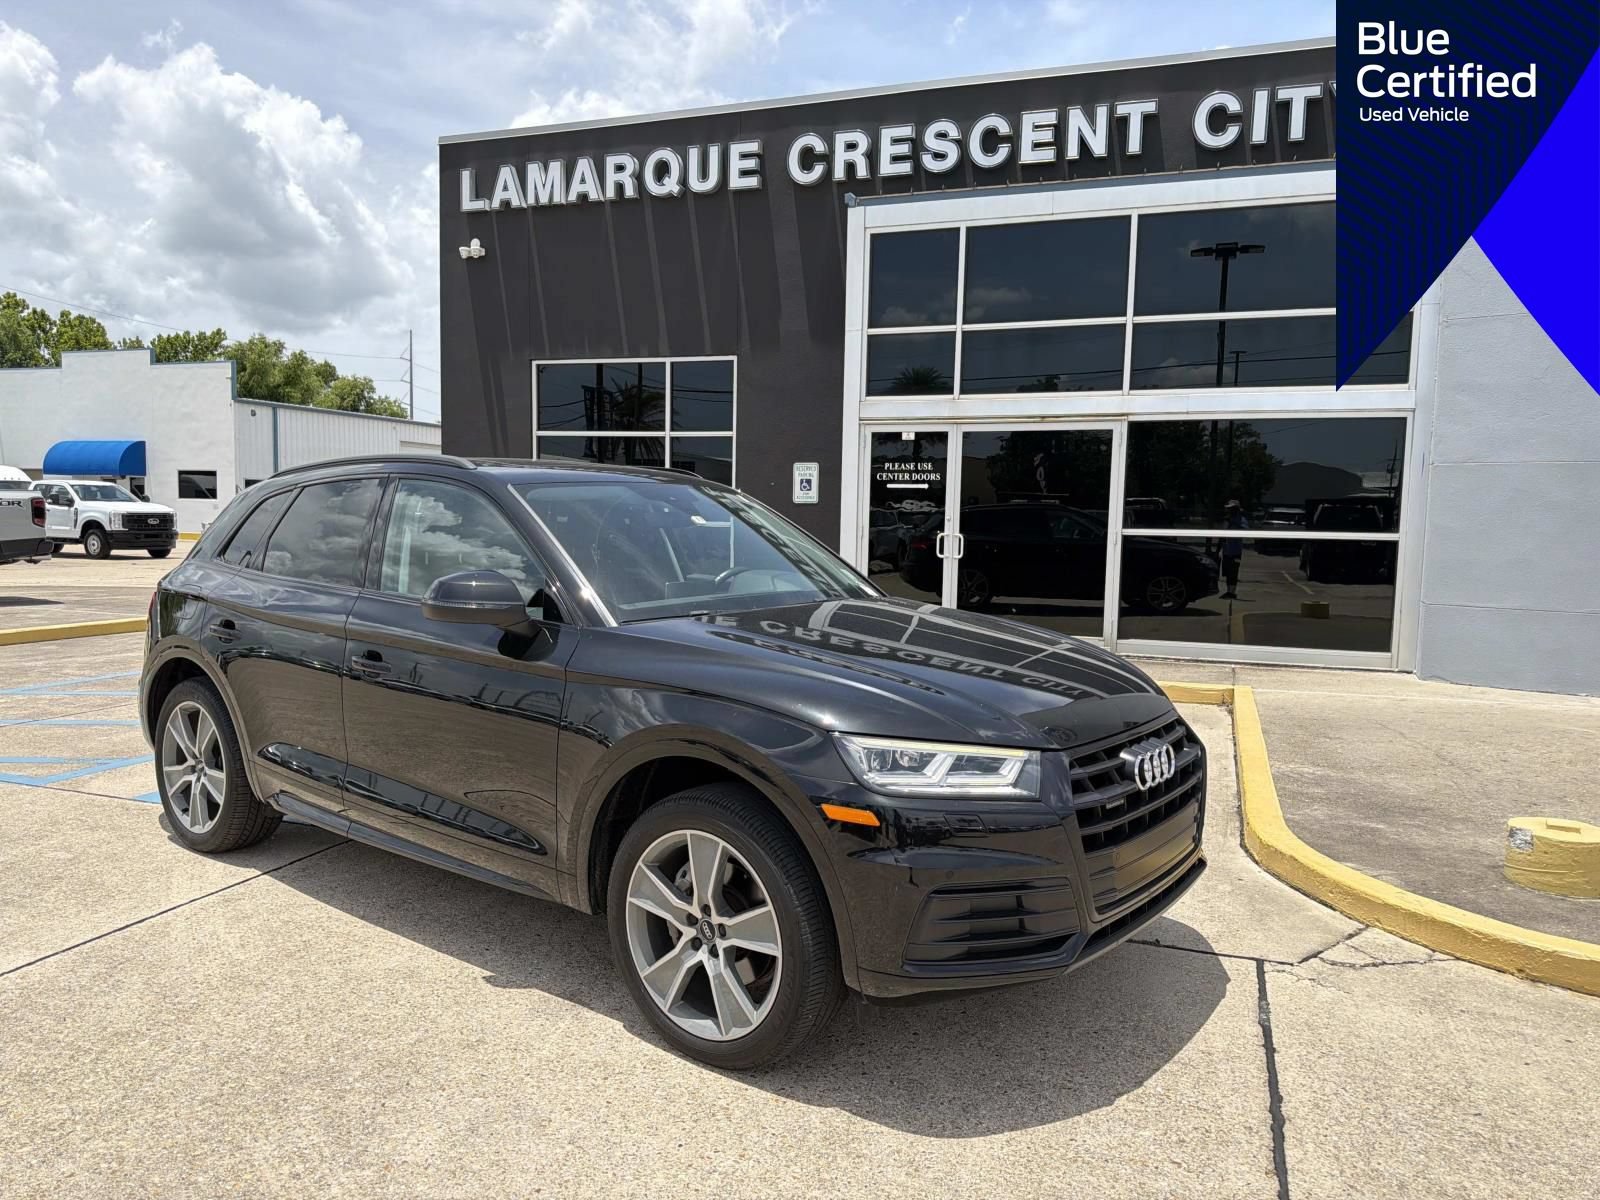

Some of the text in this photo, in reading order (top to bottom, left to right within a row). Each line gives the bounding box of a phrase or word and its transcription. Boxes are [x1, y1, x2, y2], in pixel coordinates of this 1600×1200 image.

[459, 81, 1336, 212] LAMARQUE CRESCENT CIT
[884, 462, 934, 471] PLEASE USE
[876, 472, 941, 481] CENTER DOORS
